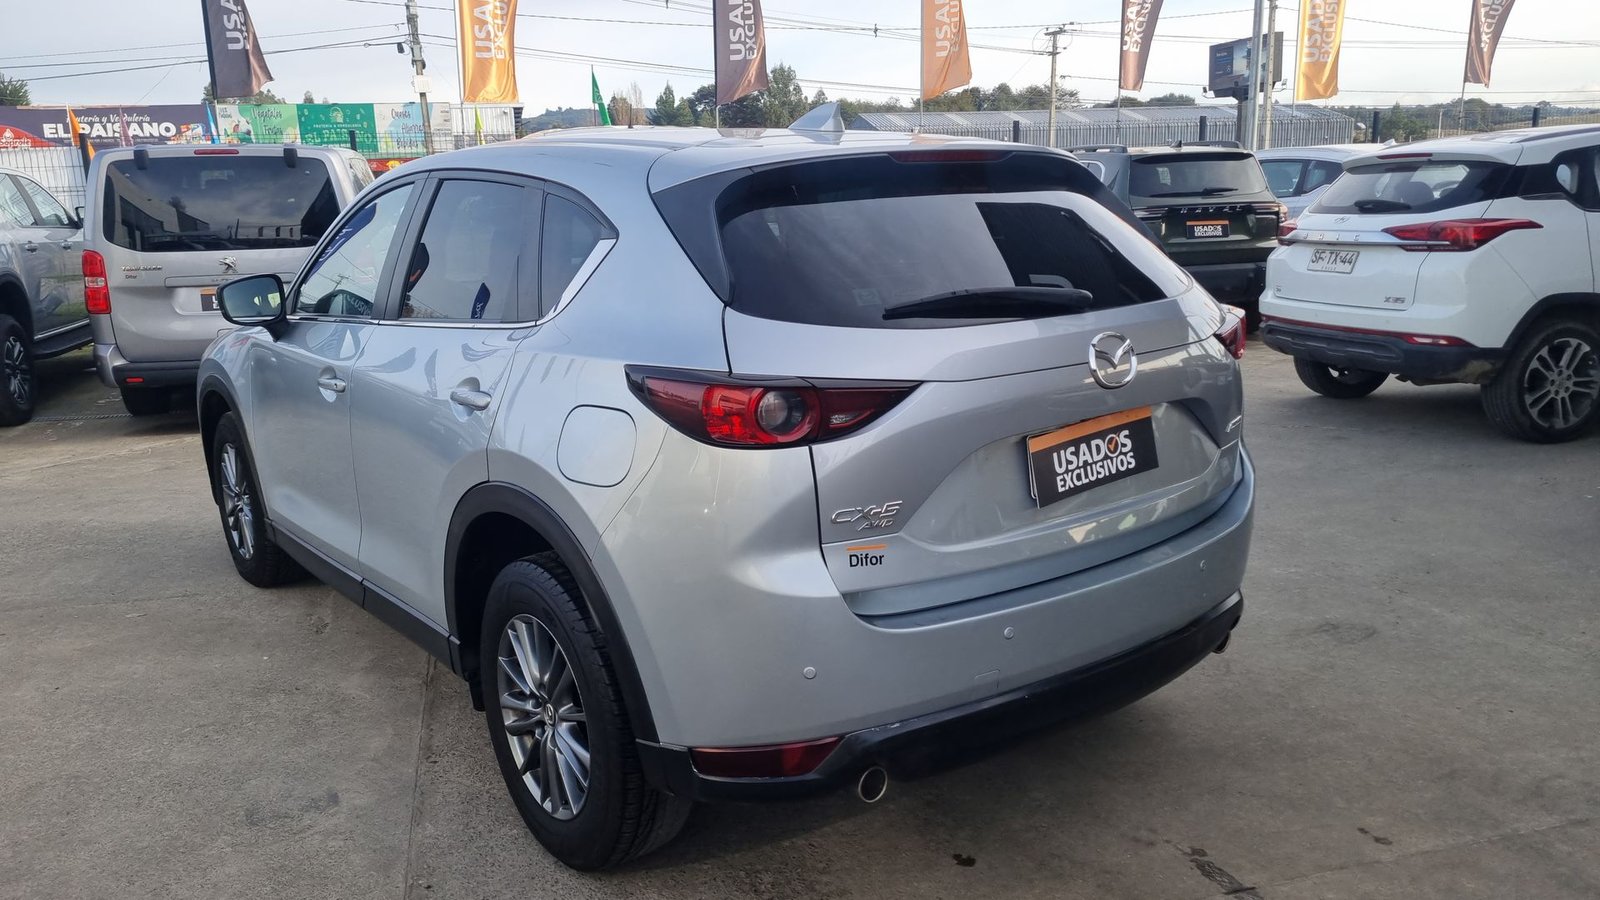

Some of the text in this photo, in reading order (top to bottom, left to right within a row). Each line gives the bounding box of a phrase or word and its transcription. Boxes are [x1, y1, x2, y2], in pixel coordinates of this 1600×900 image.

[743, 0, 757, 60] EXCLU
[43, 123, 71, 138] EL
[1194, 224, 1222, 232] USADOS
[1053, 429, 1133, 474] USADOS
[1056, 451, 1136, 493] EXCLUSIVOS
[831, 500, 903, 524] CX-5
[857, 518, 894, 531] AWD
[849, 553, 885, 567] Difor
